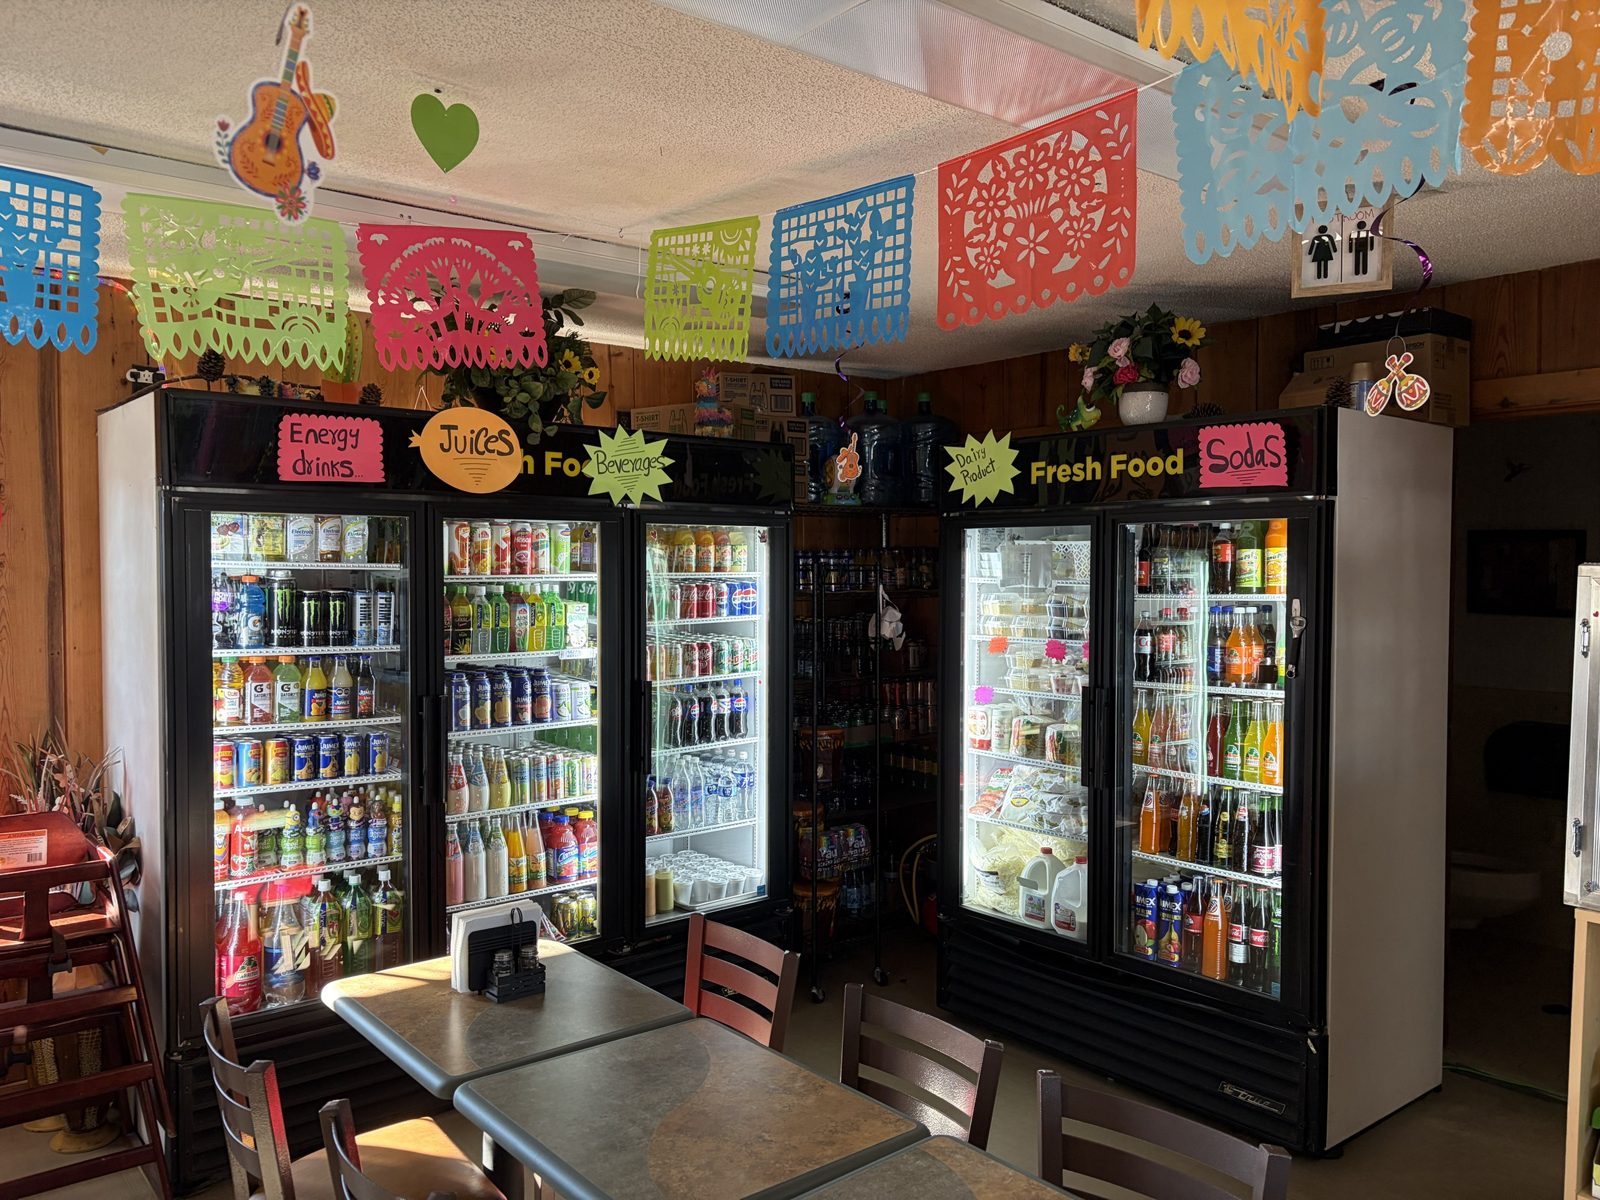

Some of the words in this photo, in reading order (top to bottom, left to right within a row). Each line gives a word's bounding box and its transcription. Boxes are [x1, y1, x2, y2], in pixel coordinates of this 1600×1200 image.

[635, 413, 659, 422] T-SHIRT
[289, 422, 360, 451] Energy
[439, 423, 515, 457] Juices
[594, 450, 667, 477] Beverages
[955, 446, 987, 470] Dairy
[1030, 455, 1102, 485] Fresh
[1110, 447, 1184, 480] Food
